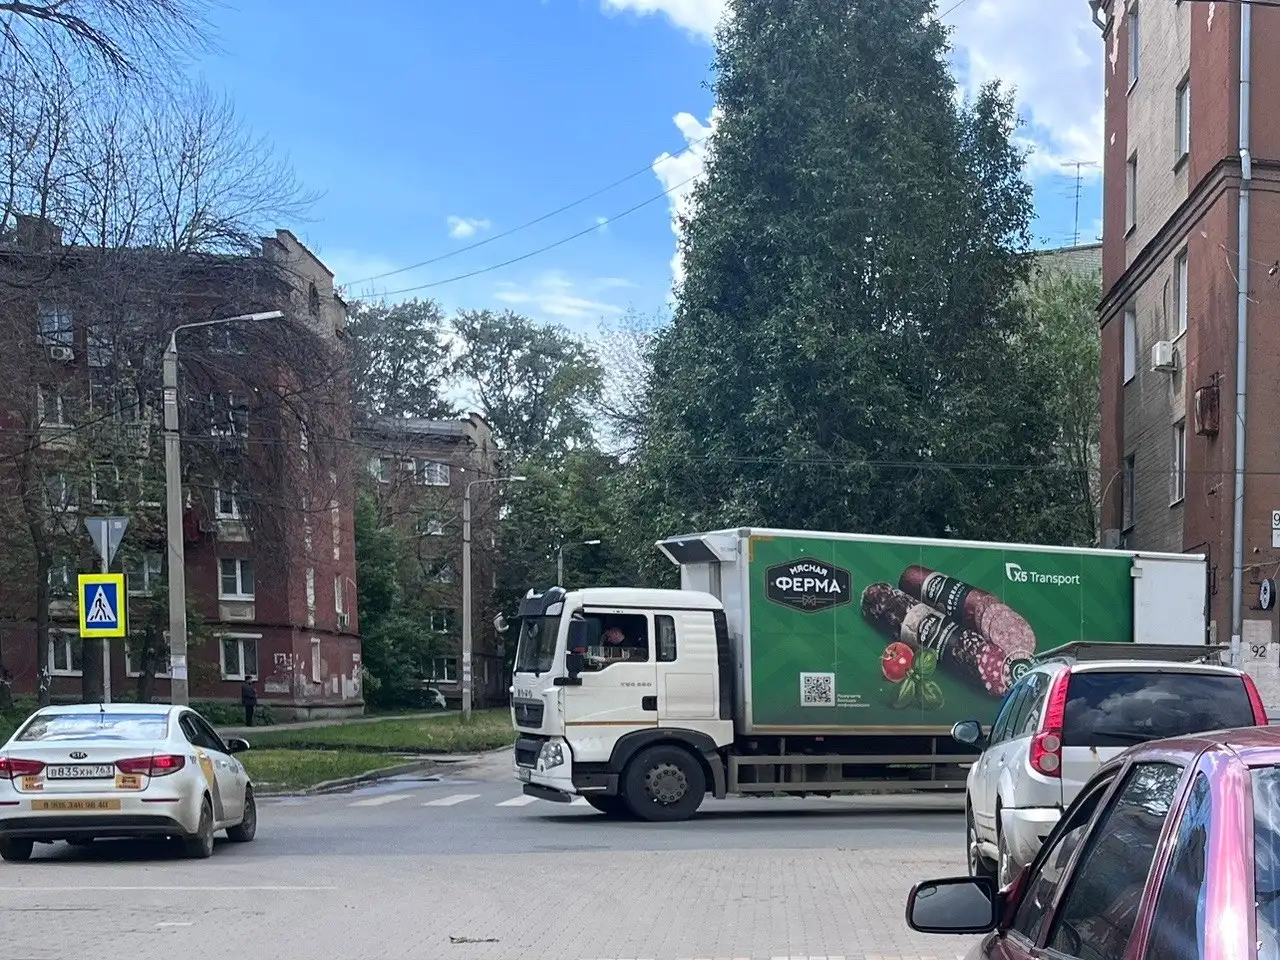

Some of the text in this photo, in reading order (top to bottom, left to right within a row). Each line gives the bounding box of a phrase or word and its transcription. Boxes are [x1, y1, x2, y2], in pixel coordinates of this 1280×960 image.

[789, 564, 828, 576] МЯСНАЯ
[775, 576, 841, 593] ФЕРМА
[1014, 571, 1080, 586] X5 Transport
[1251, 645, 1267, 658] 92
[95, 765, 111, 775] 763
